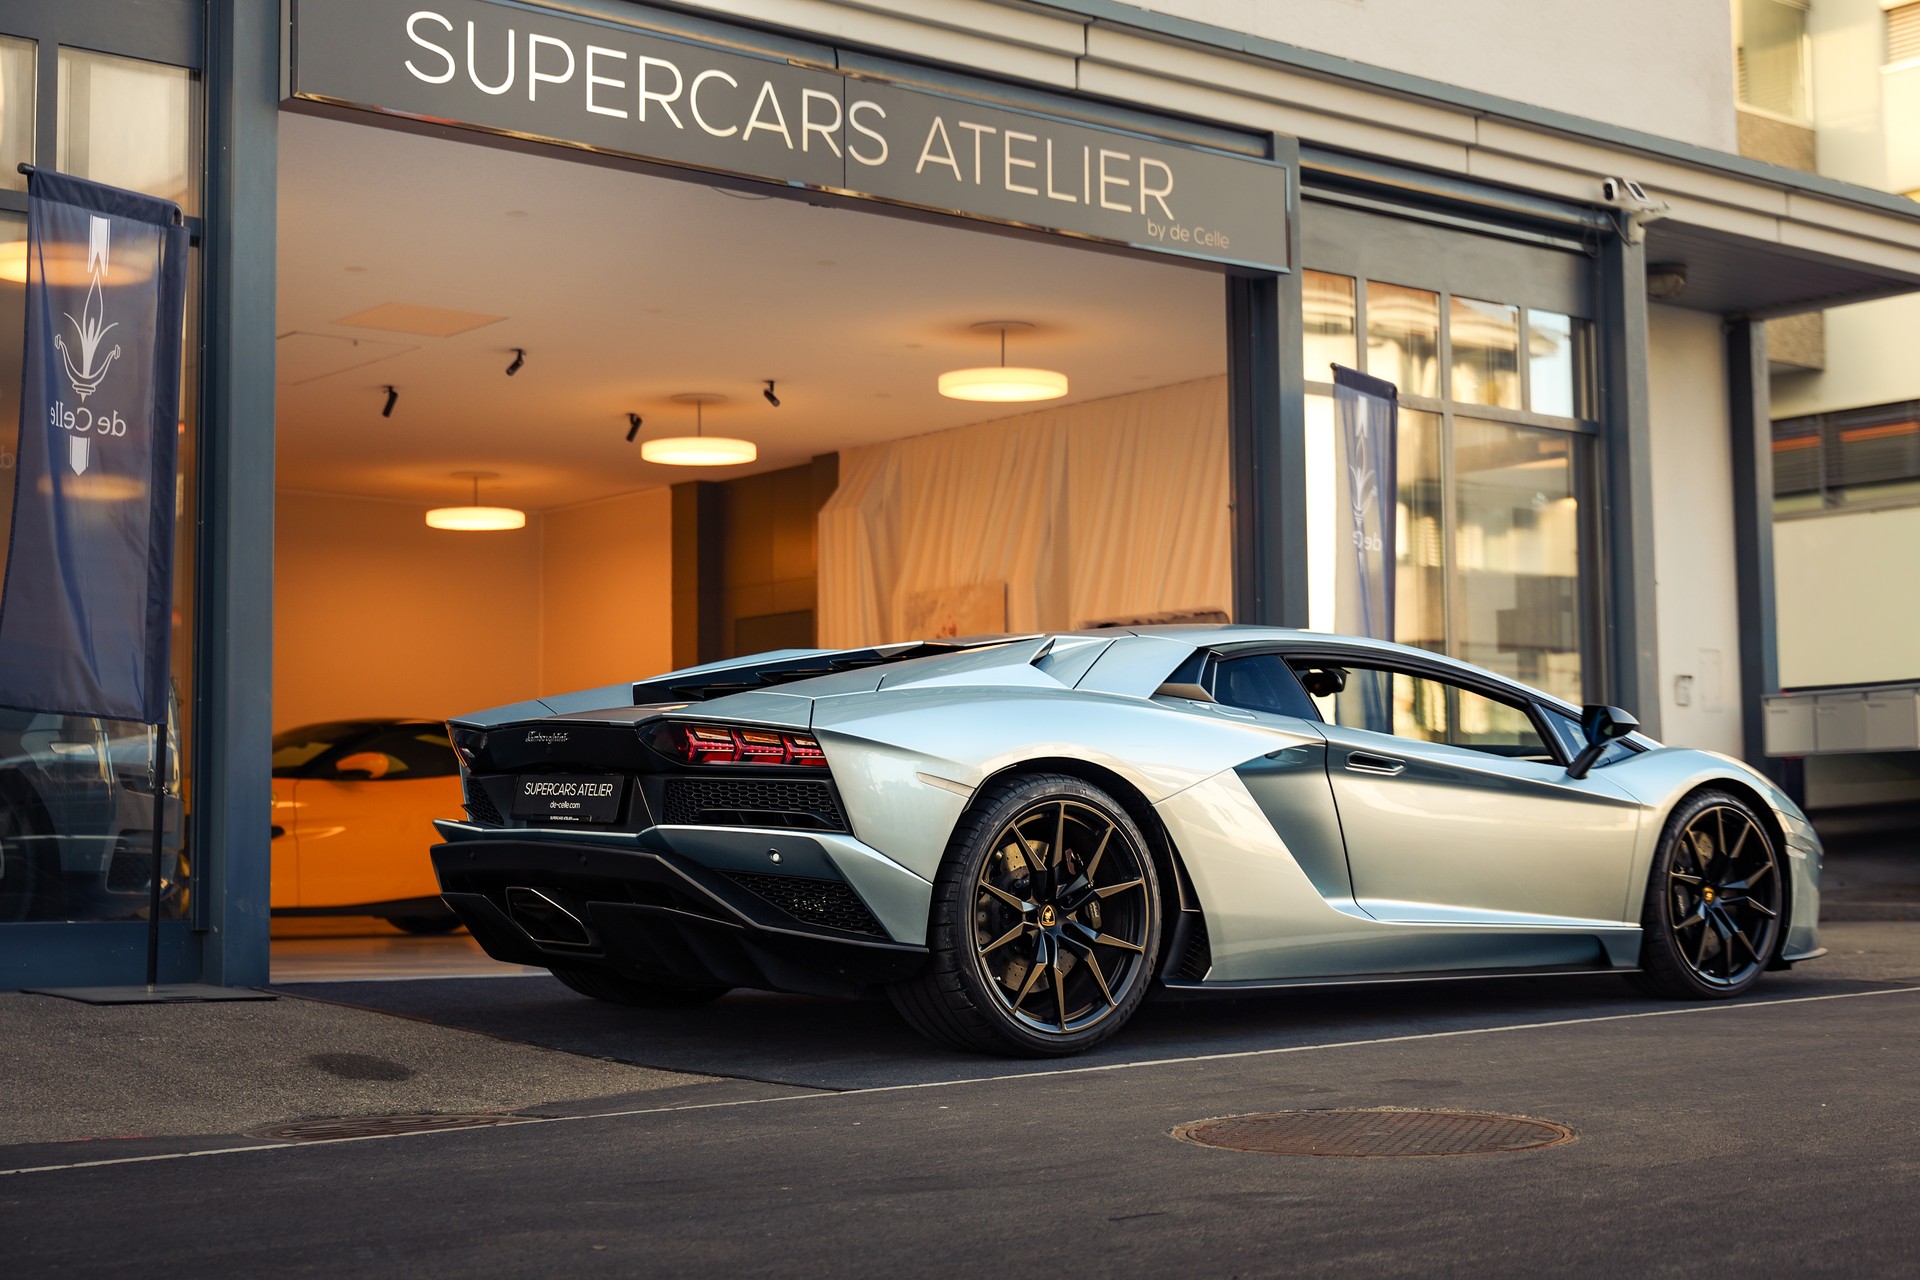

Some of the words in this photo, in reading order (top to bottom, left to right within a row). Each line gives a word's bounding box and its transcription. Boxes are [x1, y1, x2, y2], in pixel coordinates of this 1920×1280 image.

[404, 10, 889, 168] SUPERCARS
[915, 115, 1175, 221] ATELIER
[1147, 217, 1166, 242] by
[1170, 223, 1190, 242] de
[1194, 226, 1230, 249] Celle
[524, 782, 577, 796] SUPERCARS
[577, 783, 613, 797] ATELIER
[549, 800, 581, 809] de-celle.com
